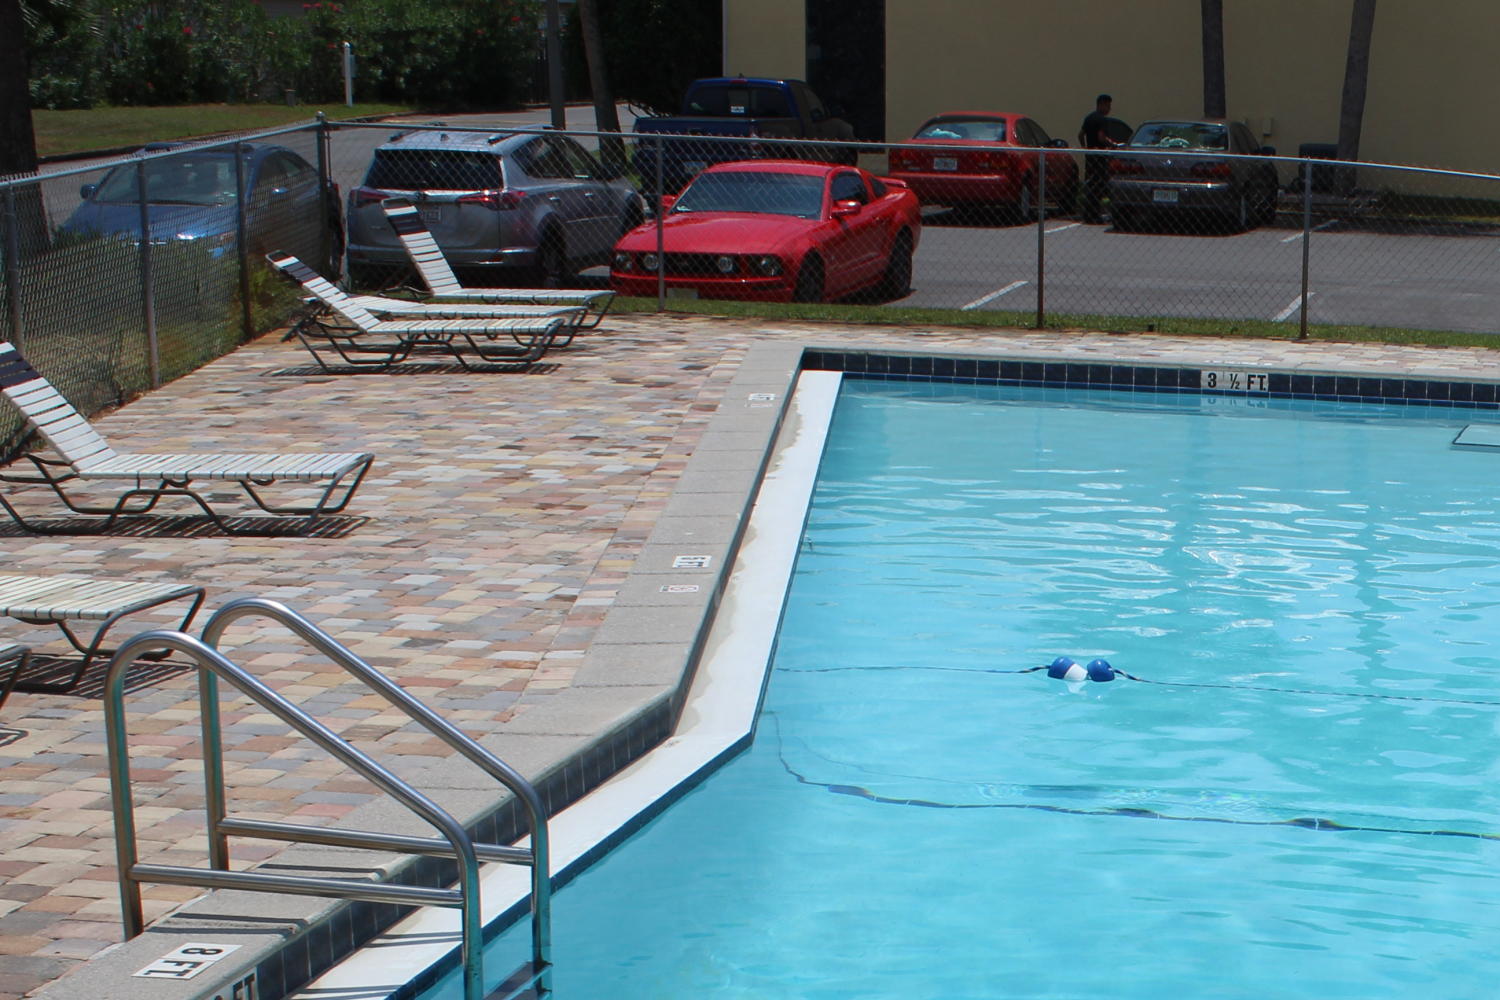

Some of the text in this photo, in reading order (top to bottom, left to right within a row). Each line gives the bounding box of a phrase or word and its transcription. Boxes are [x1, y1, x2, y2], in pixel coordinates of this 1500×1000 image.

[1207, 372, 1217, 389] 3
[1247, 373, 1267, 391] FT.
[142, 947, 224, 977] 8 FT.
